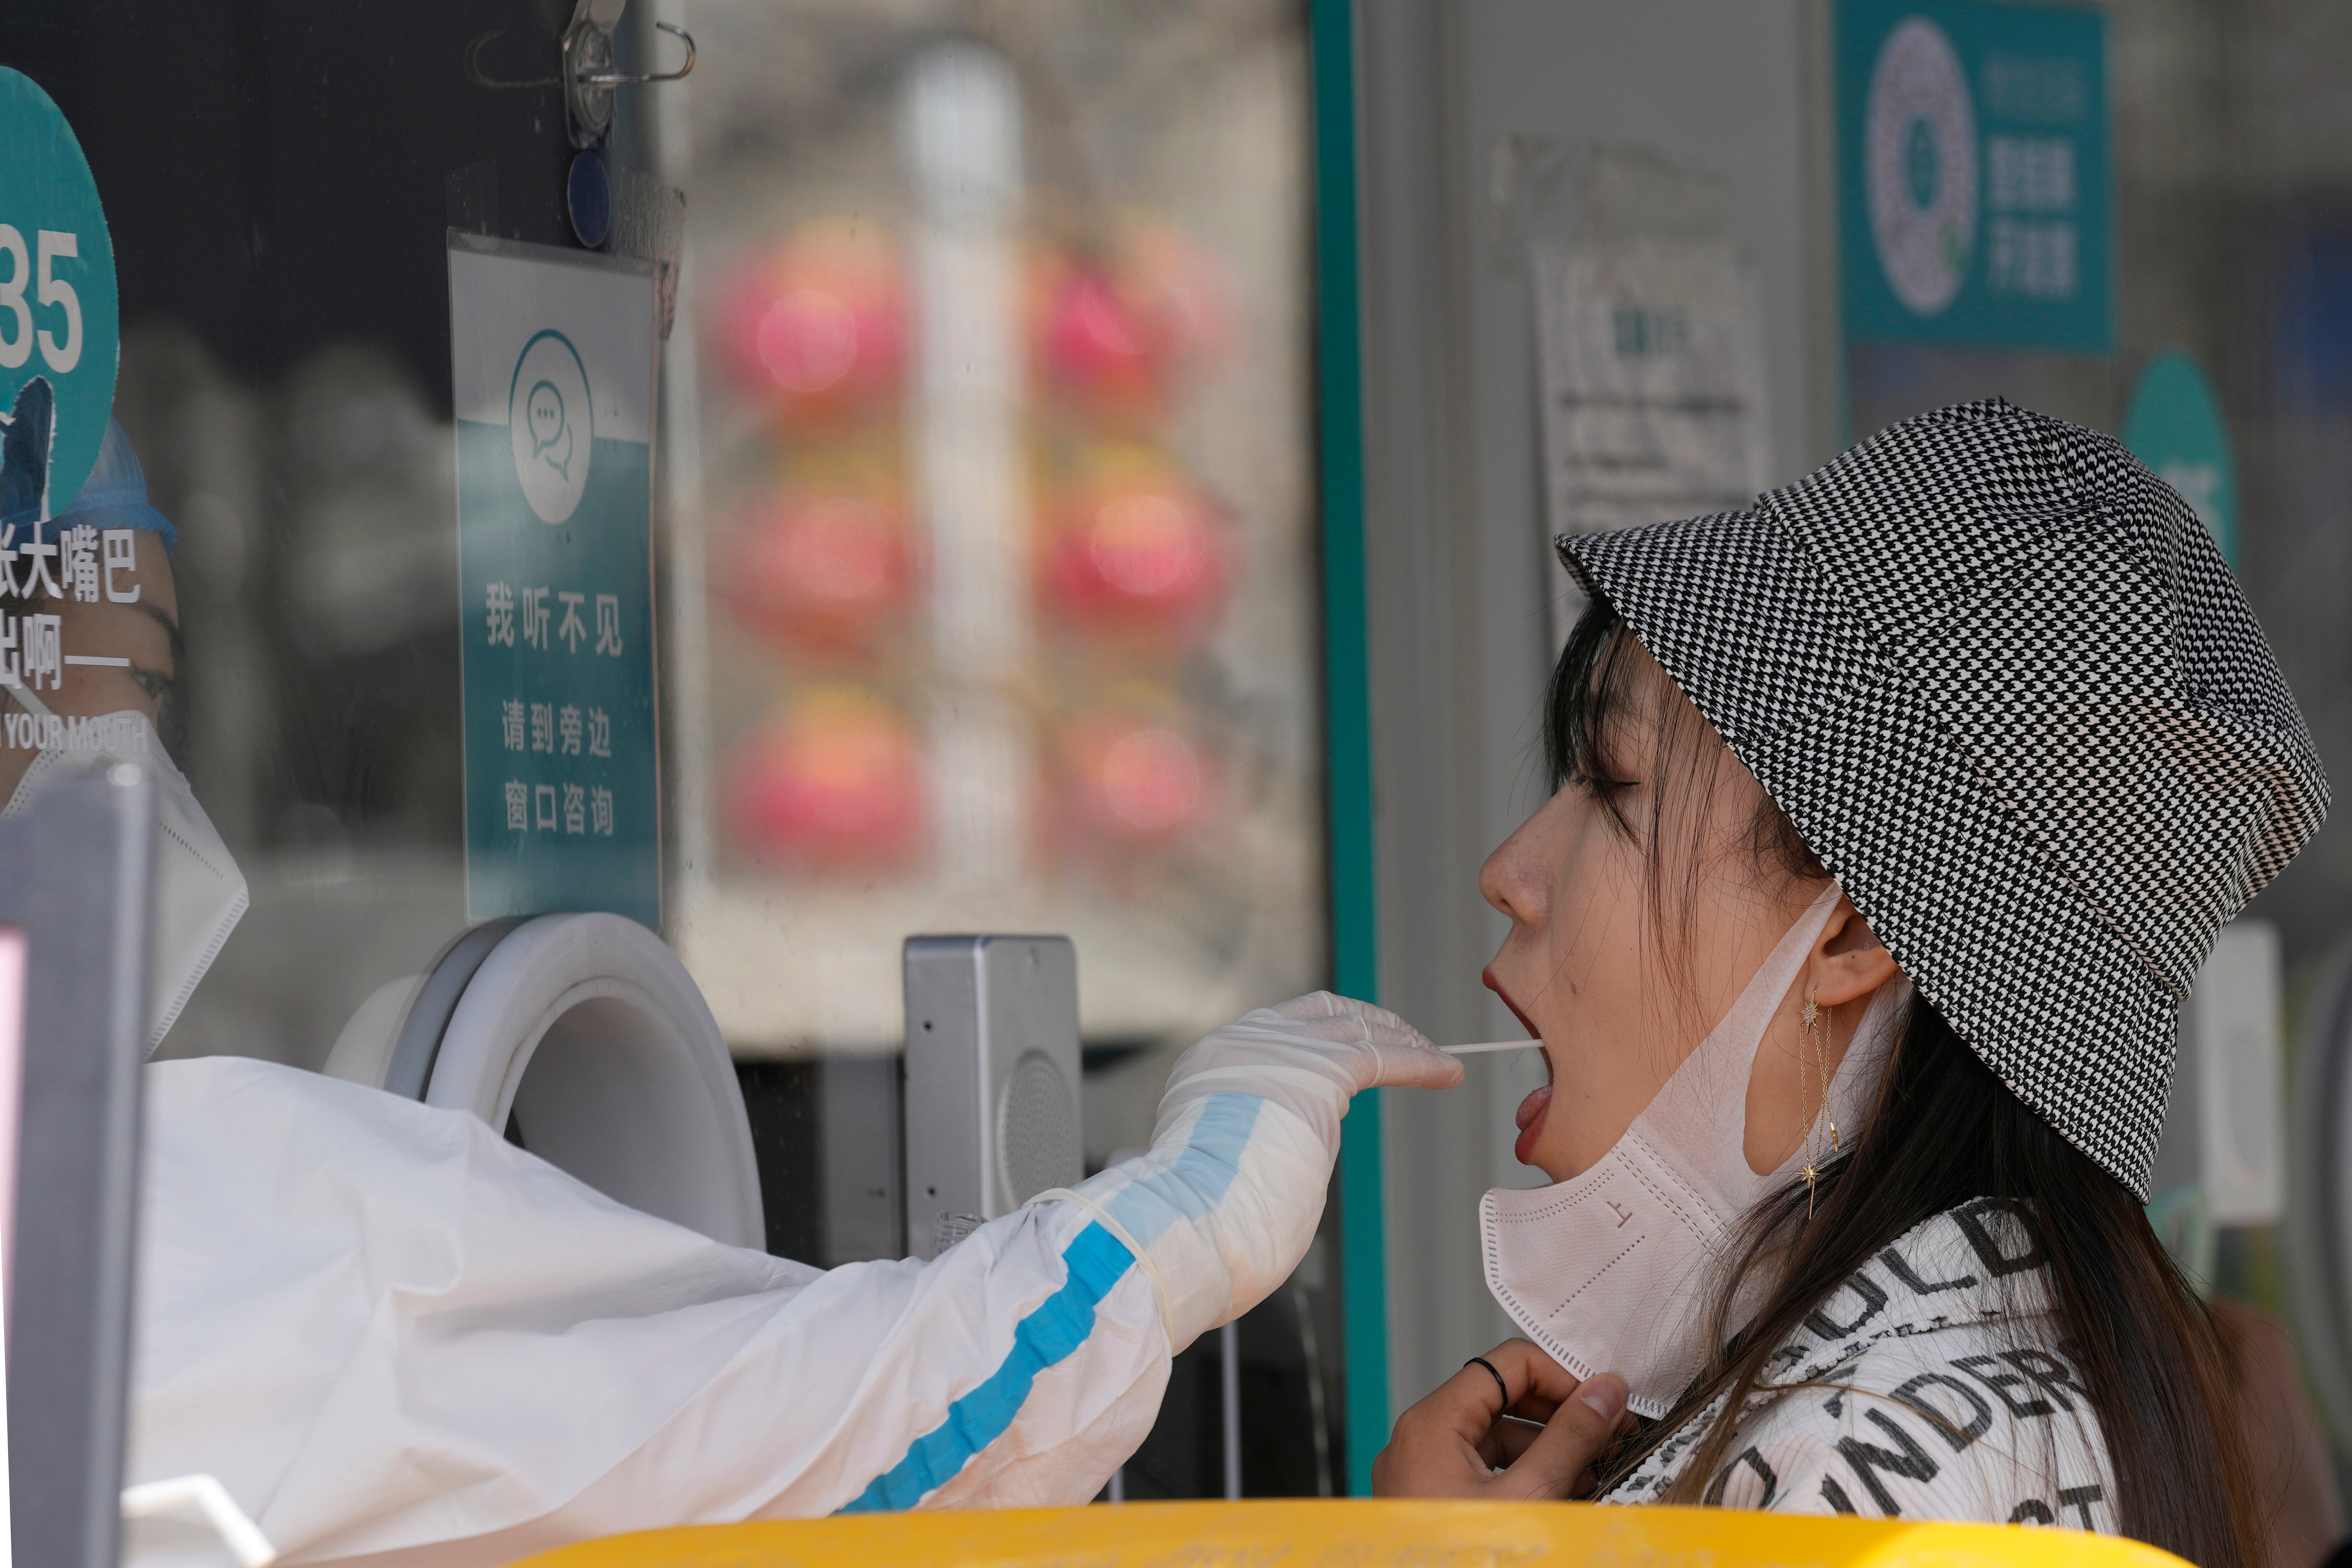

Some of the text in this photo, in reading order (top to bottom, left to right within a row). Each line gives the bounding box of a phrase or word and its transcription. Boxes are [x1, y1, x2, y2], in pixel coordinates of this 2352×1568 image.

[486, 581, 622, 657] 我听不见
[4, 713, 148, 753] YOUR MOUTH
[502, 699, 611, 758] 请到旁边
[505, 779, 613, 837] 窗口咨询
